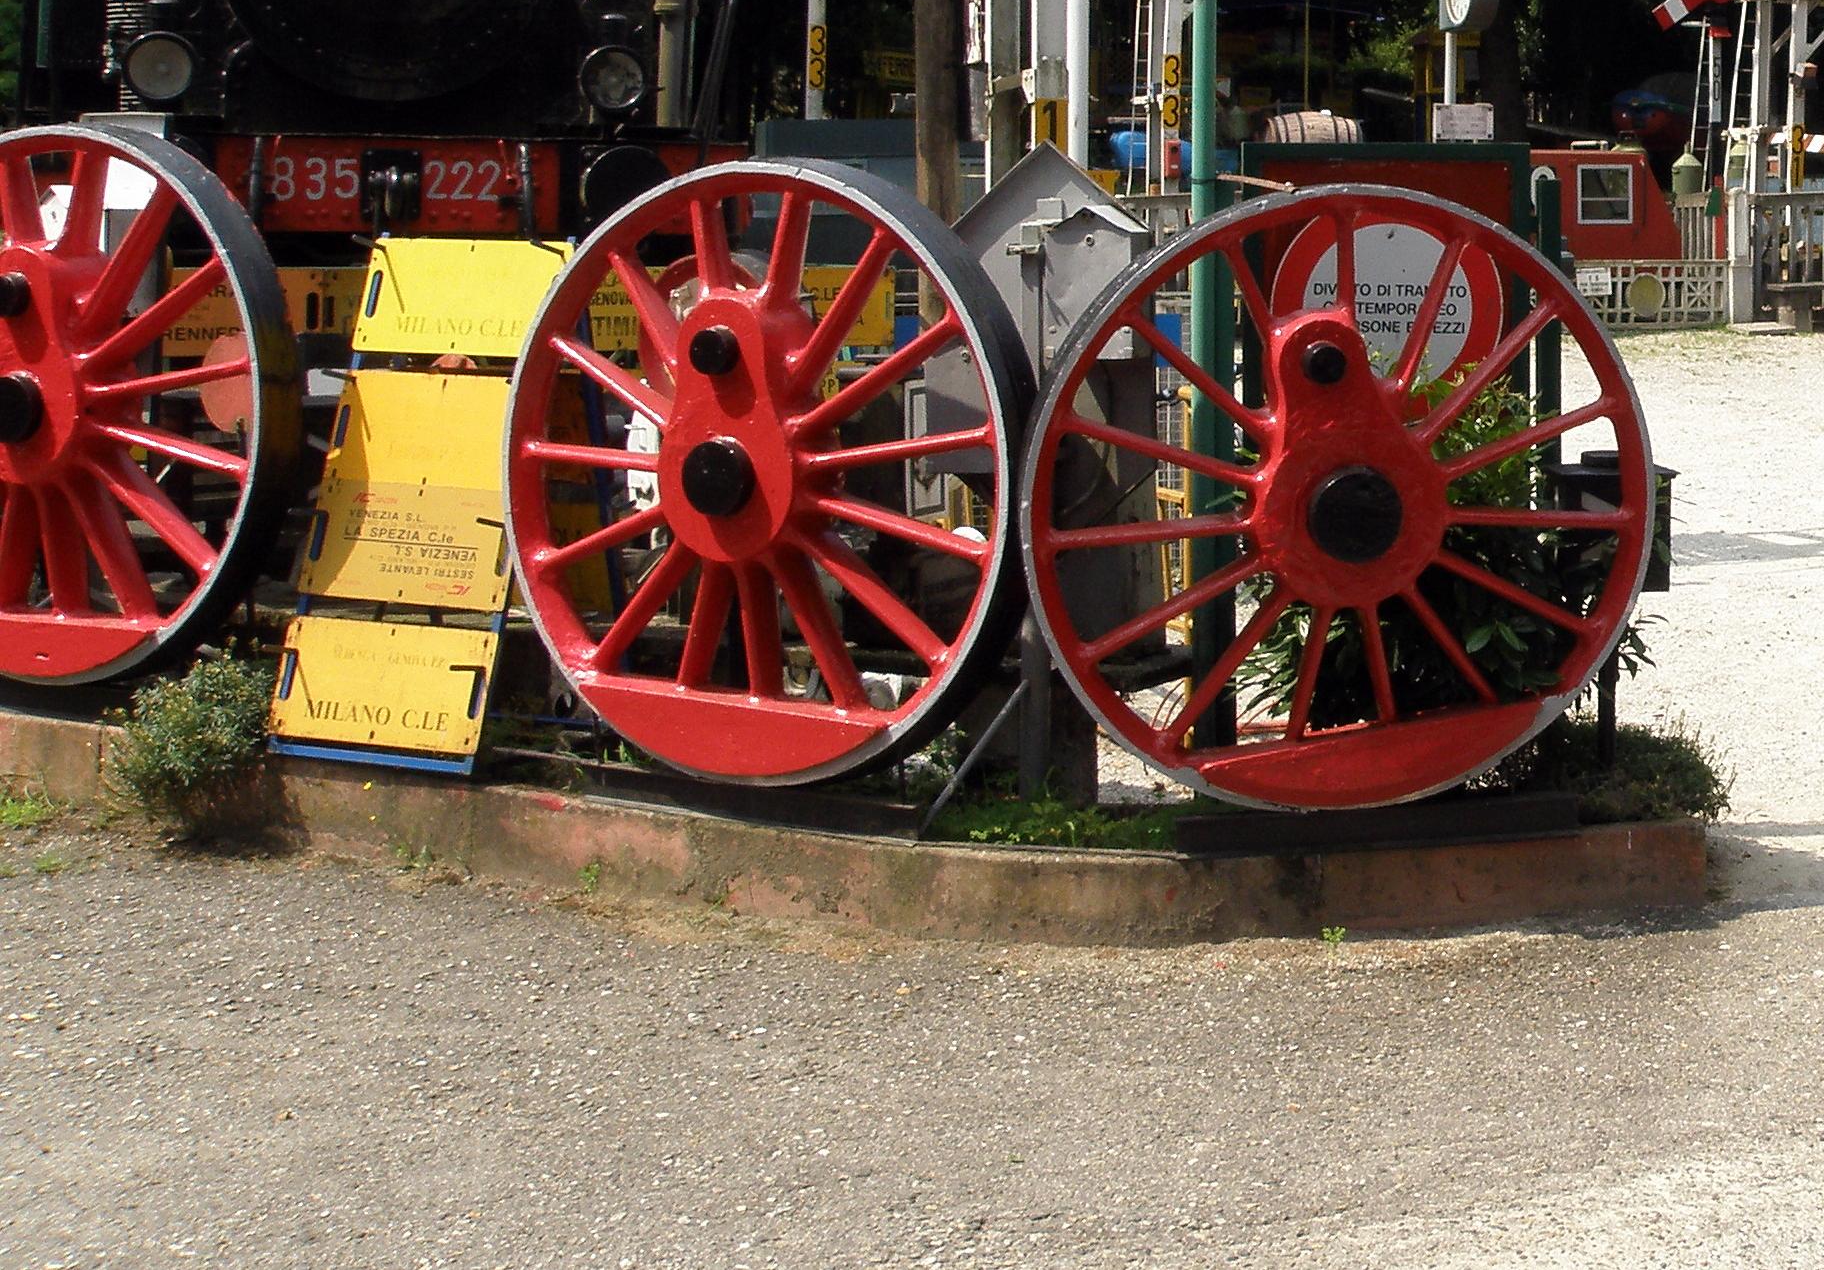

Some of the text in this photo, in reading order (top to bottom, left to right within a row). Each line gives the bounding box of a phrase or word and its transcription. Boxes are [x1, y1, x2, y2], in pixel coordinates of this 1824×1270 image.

[271, 156, 501, 201] 835 222
[1313, 283, 1371, 297] DIVTO
[1377, 284, 1391, 297] DI
[395, 315, 473, 337] MILANO
[350, 509, 400, 522] VENEZIA
[344, 526, 361, 536] LA
[369, 527, 420, 542] SPEZIA
[420, 547, 478, 562] VENEZIA
[379, 563, 474, 580] SESTRI LEVANTE
[304, 699, 450, 732] MILANO C.LE
